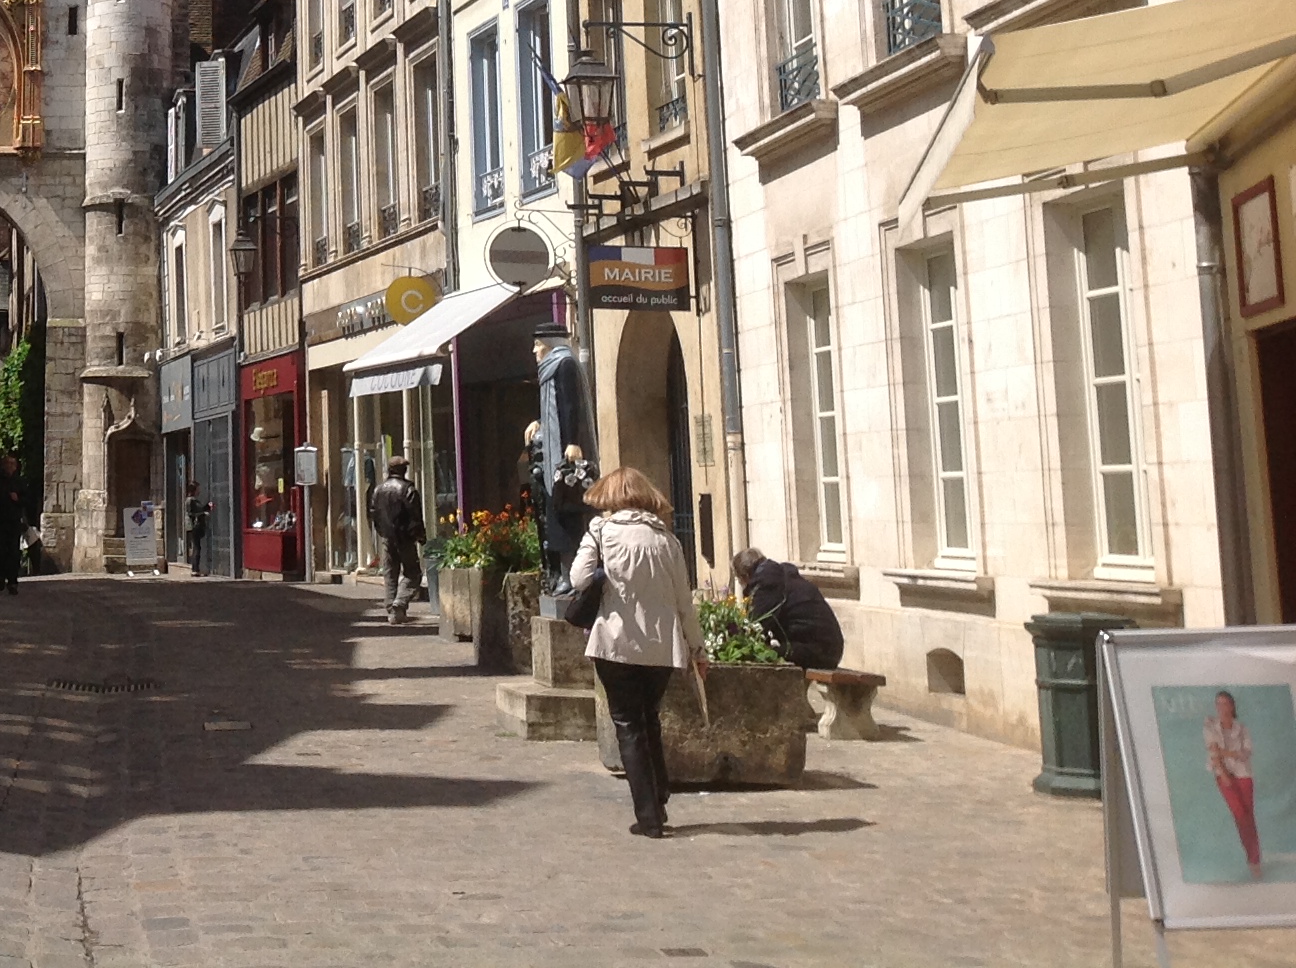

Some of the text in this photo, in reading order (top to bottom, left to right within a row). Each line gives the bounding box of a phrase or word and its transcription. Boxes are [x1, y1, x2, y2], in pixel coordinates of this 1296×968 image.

[604, 267, 674, 282] MAIRIE
[401, 289, 423, 314] C
[601, 293, 678, 306] accueil du public
